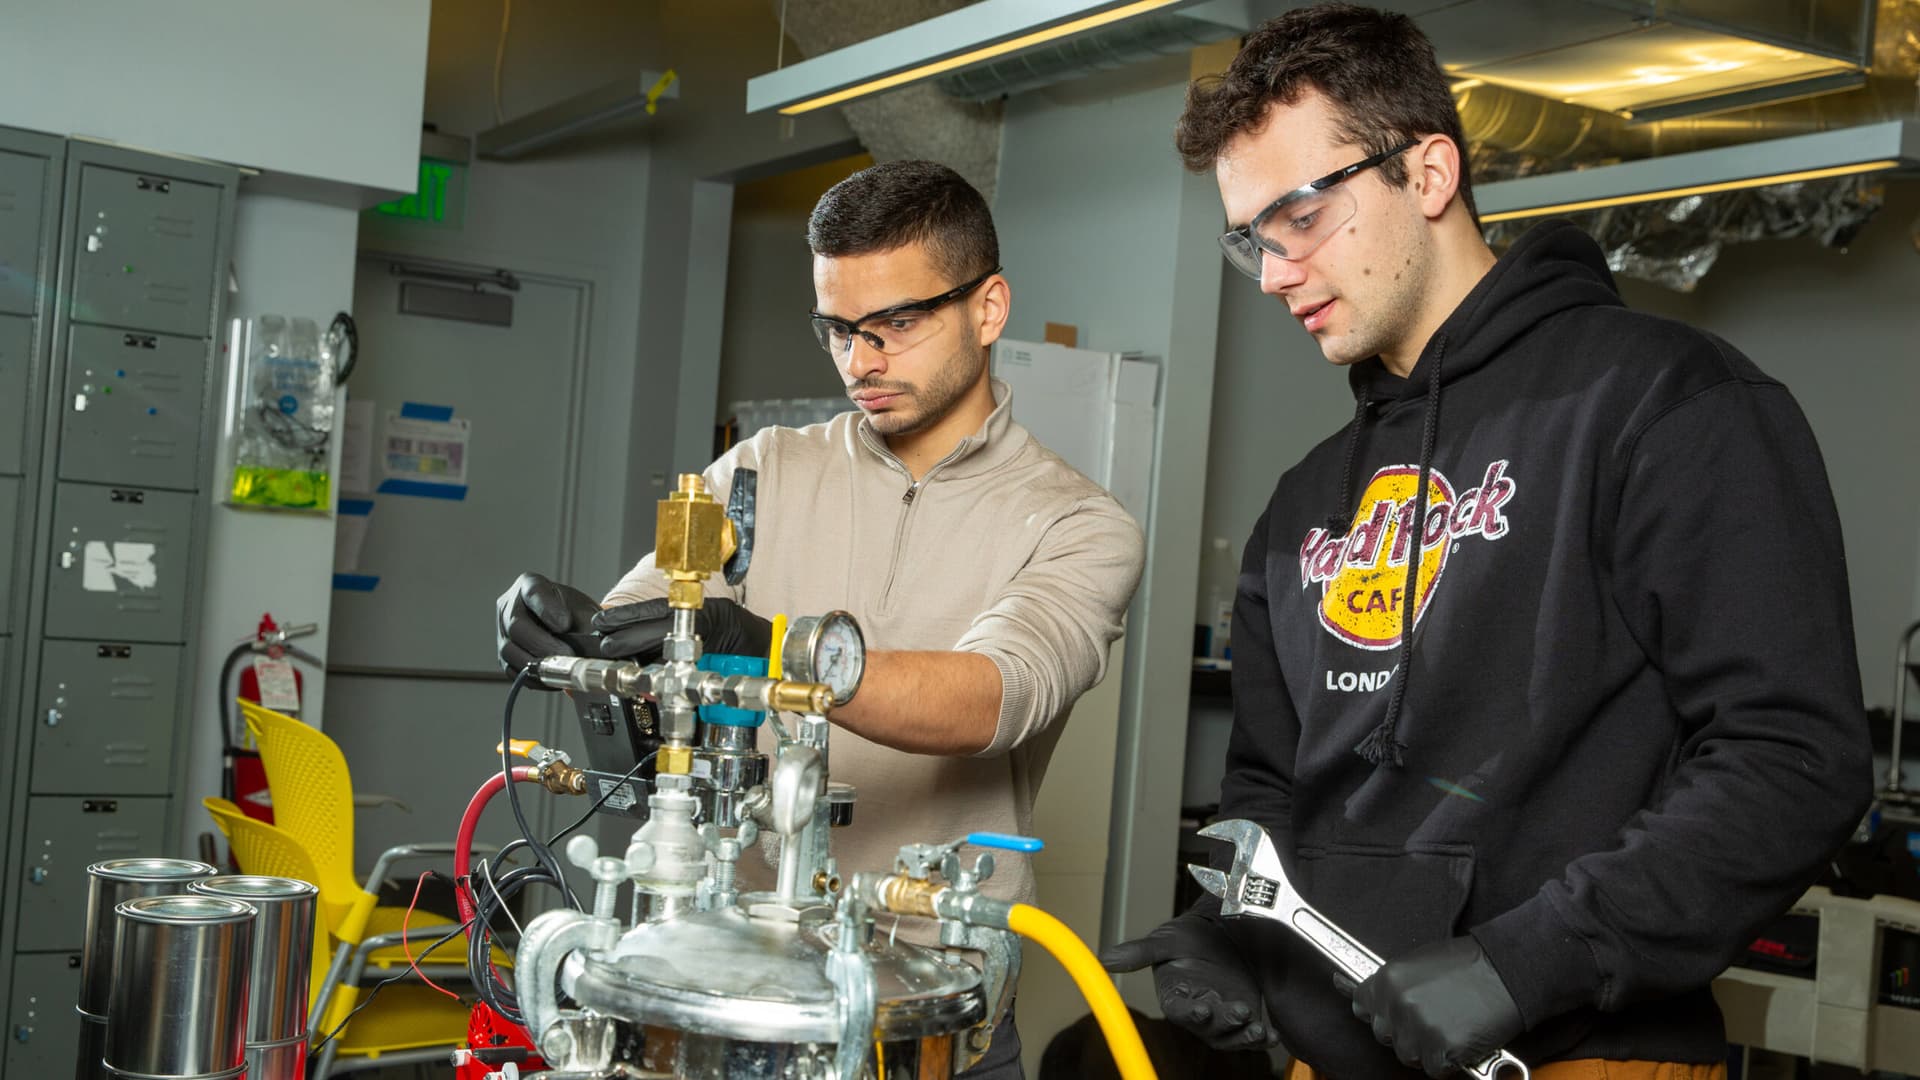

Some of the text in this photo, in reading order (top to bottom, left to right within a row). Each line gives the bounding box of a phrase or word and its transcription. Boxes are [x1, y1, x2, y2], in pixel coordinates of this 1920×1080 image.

[377, 161, 452, 222] IT
[1300, 500, 1395, 591] Had
[1346, 587, 1404, 614] CAF
[1326, 664, 1400, 692] LOND
